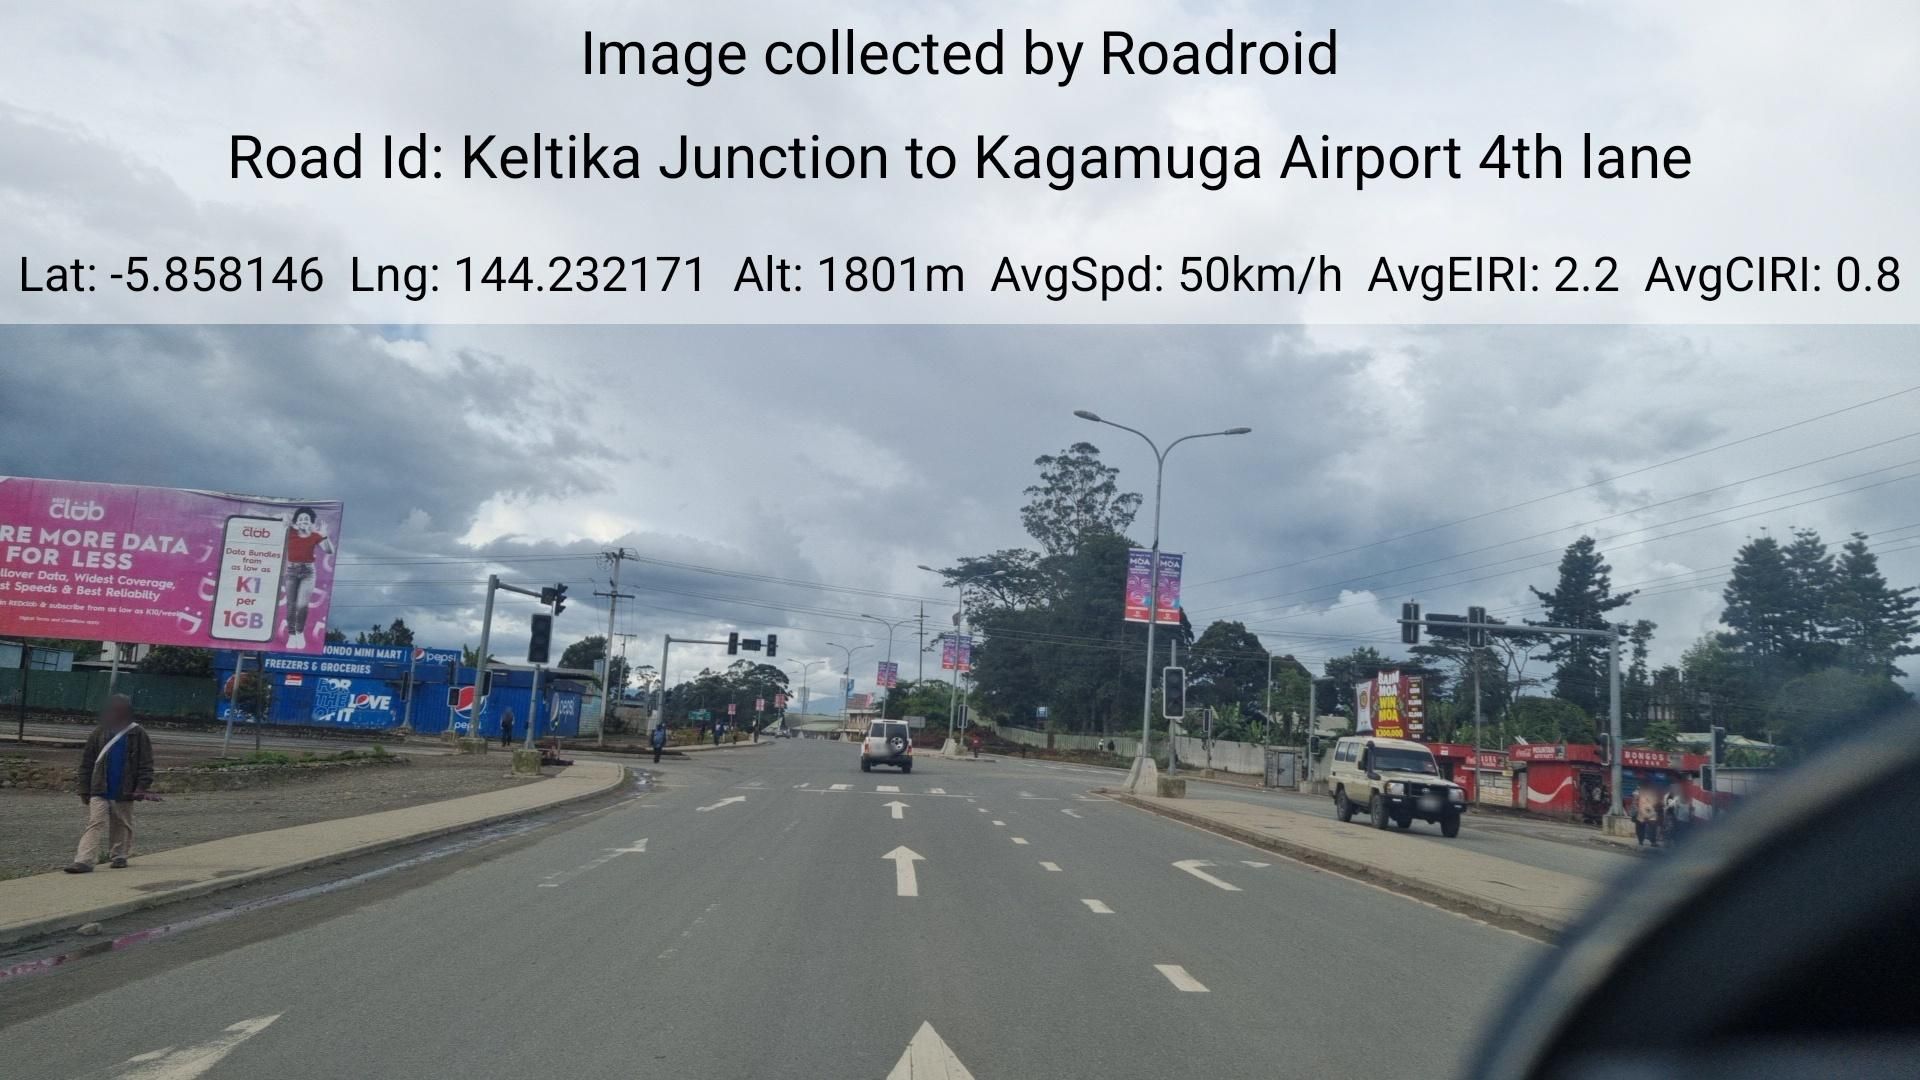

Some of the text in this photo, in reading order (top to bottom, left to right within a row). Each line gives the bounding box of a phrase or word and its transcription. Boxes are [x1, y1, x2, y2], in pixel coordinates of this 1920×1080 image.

[40, 527, 116, 549] MORE
[122, 533, 189, 555] DATA
[6, 546, 133, 570] FOR LESS
[225, 547, 281, 559] Data Bundles
[244, 564, 258, 572] low
[1129, 557, 1151, 566] MOA
[1160, 560, 1180, 568] MOA
[38, 571, 68, 583] Data,
[74, 573, 114, 585] Widest
[118, 576, 176, 592] Coverage,
[236, 576, 262, 594] K1
[15, 582, 58, 593] Speeds
[62, 585, 73, 594] &
[76, 585, 102, 596] Best
[236, 598, 256, 607] per
[223, 610, 264, 629] 1GB
[354, 647, 376, 658] MINI
[376, 649, 402, 660] MART
[426, 652, 457, 665] pepsi
[264, 658, 371, 674] FREEZERS & GROCERIES
[317, 677, 352, 692] FOR
[1379, 684, 1398, 697] MOA
[315, 691, 348, 708] THE
[1379, 696, 1397, 709] WIN
[336, 707, 355, 722] IT
[1378, 708, 1399, 723] MOA
